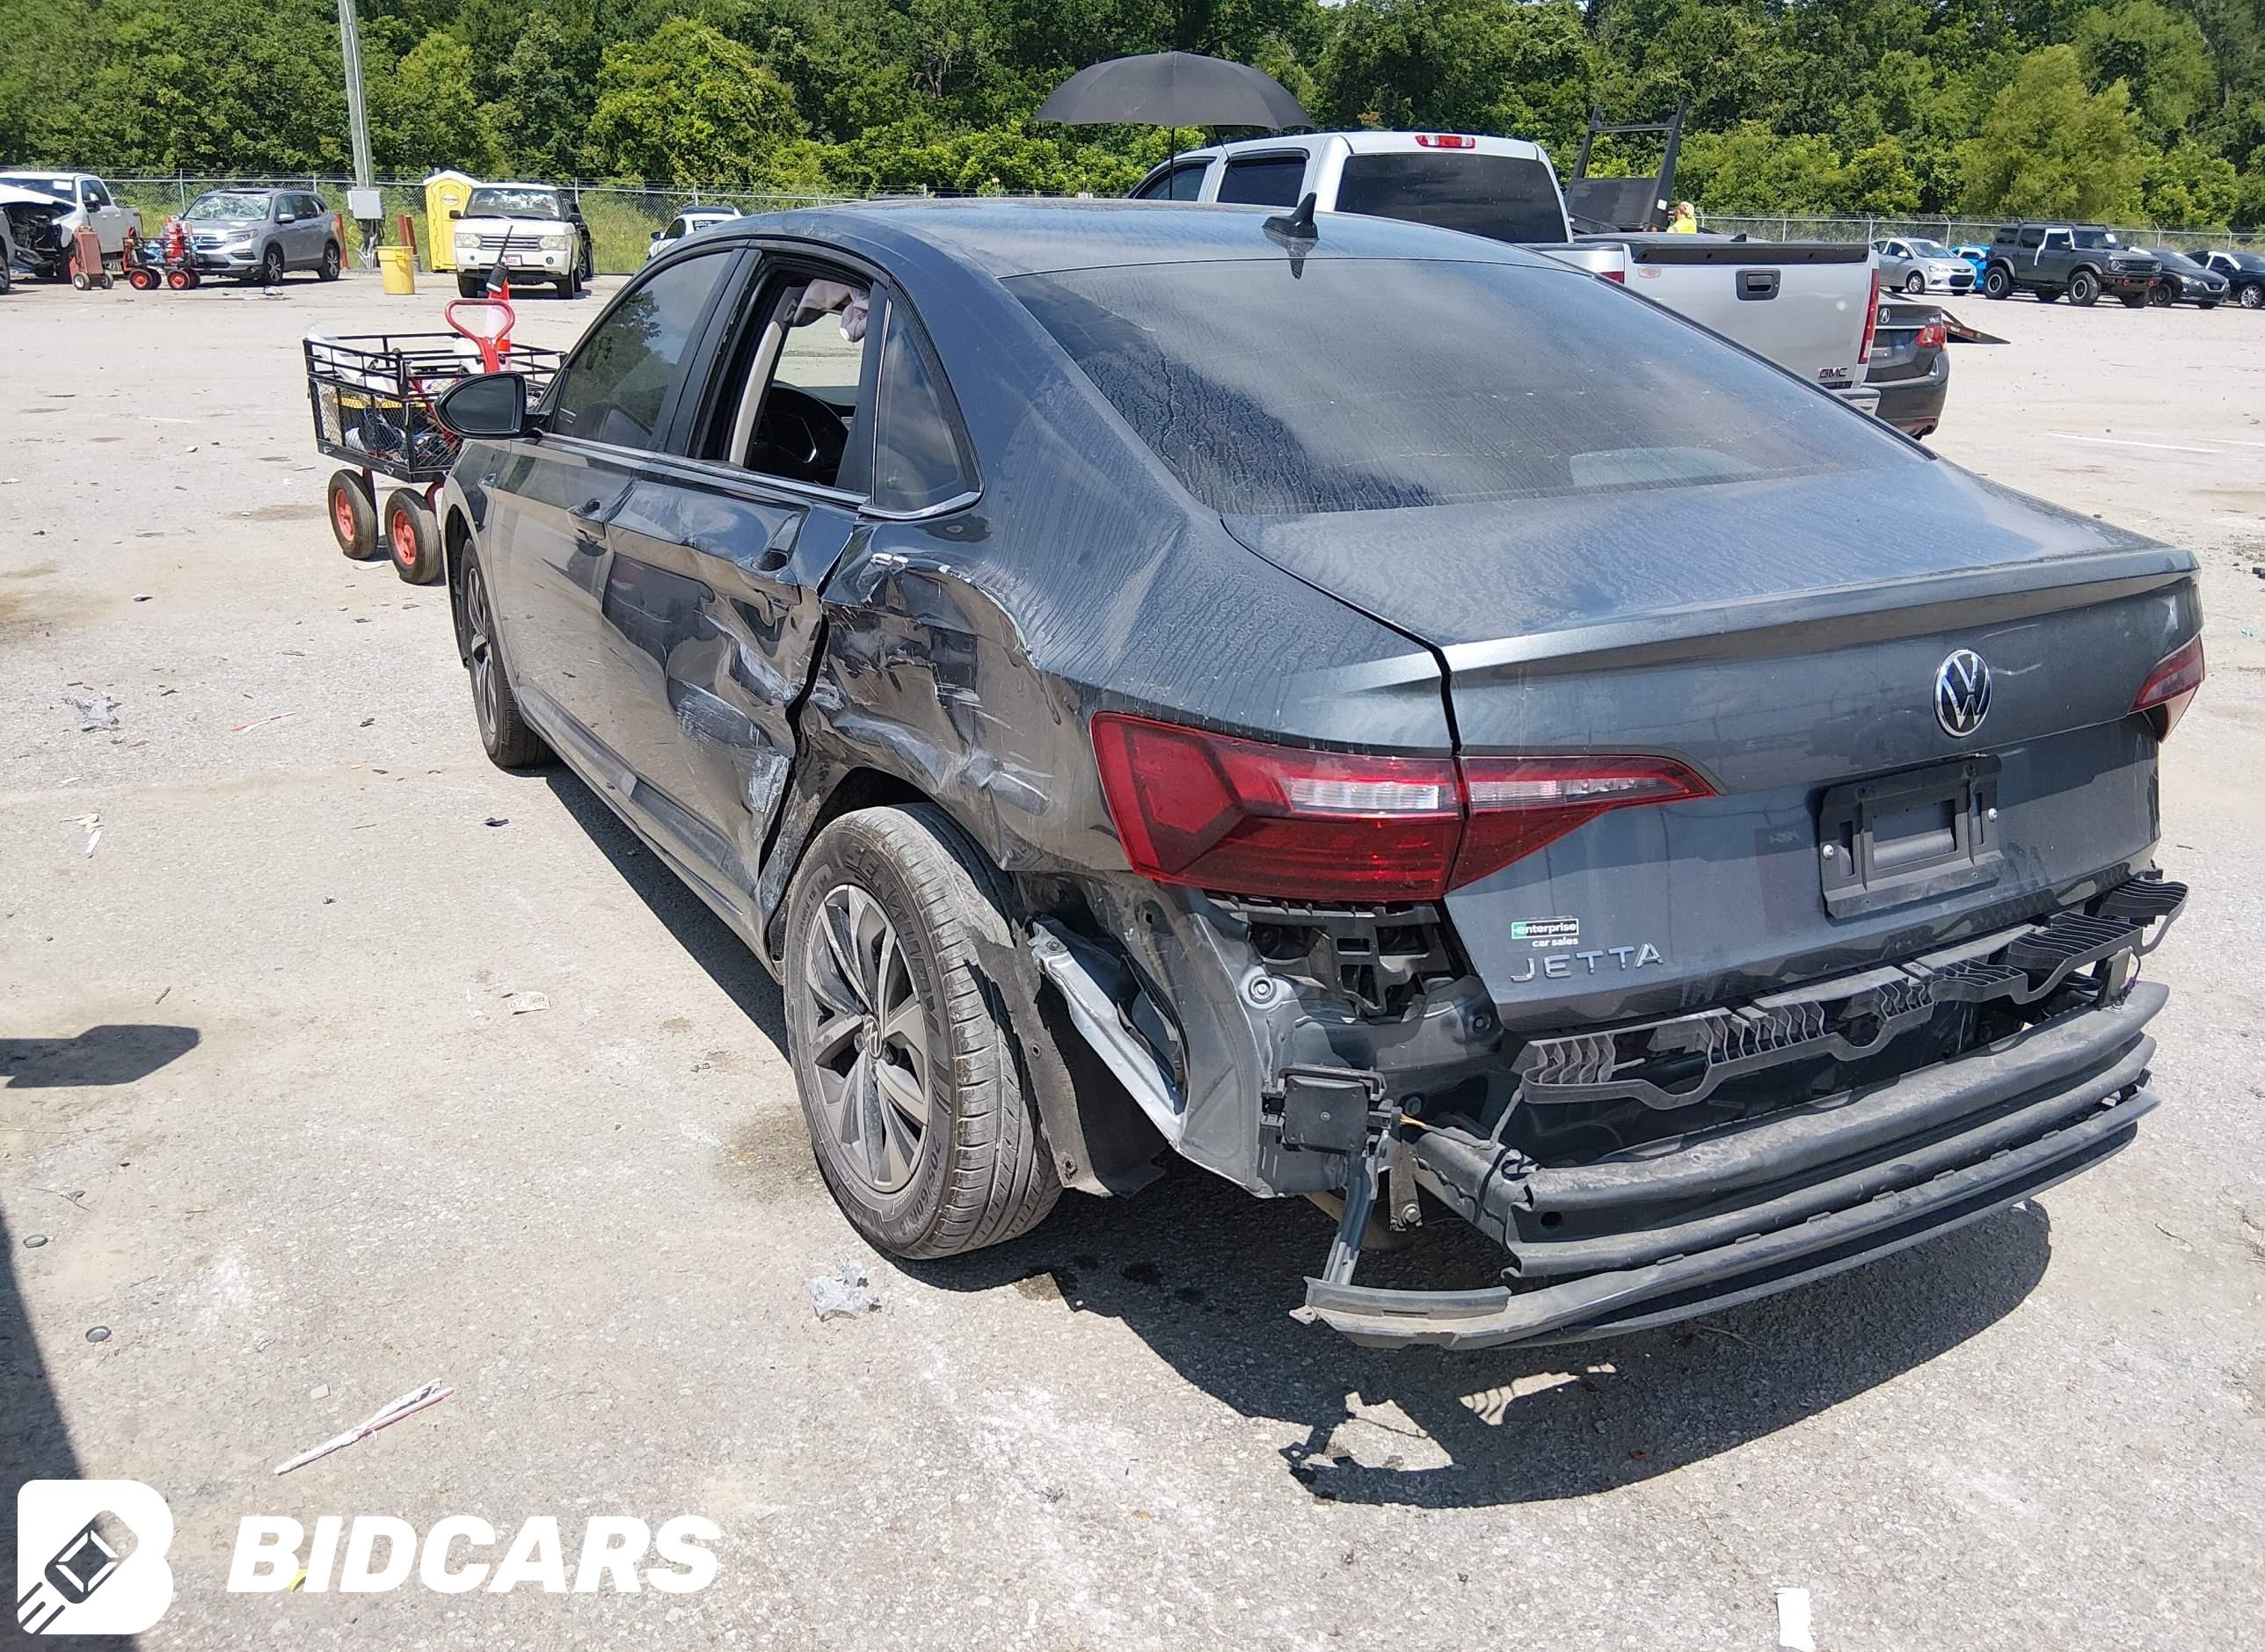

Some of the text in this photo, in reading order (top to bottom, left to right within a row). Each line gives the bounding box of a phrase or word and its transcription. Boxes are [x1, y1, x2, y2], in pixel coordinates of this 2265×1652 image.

[1818, 368, 1847, 379] GMC
[1514, 921, 1577, 935] enterprise
[1532, 936, 1579, 948] car sales
[1511, 942, 1664, 982] JETTA
